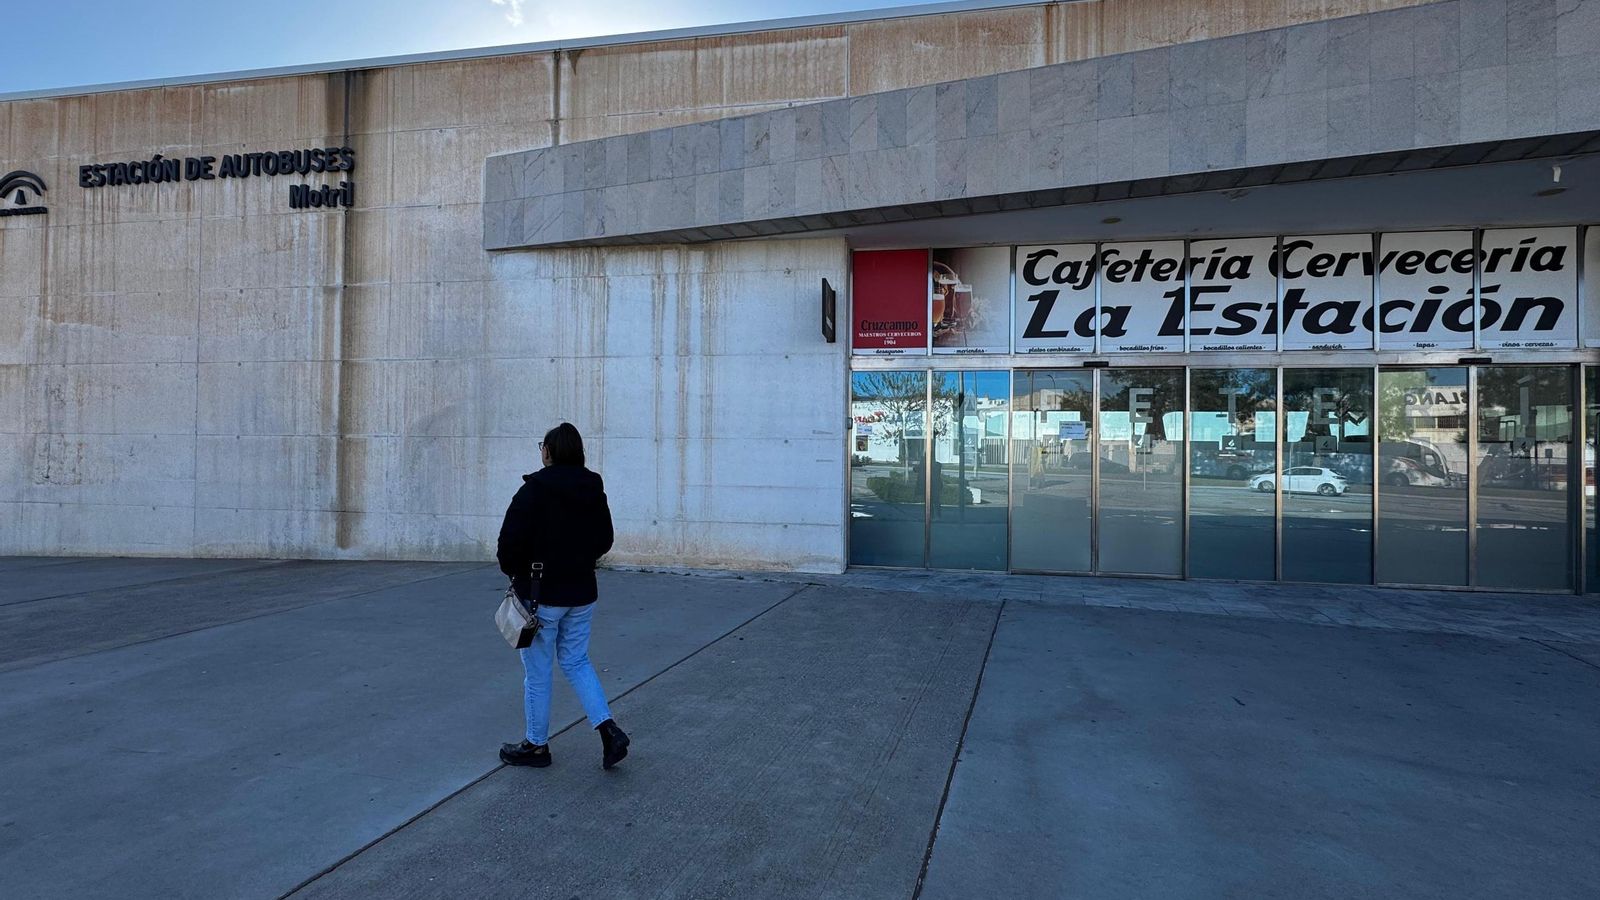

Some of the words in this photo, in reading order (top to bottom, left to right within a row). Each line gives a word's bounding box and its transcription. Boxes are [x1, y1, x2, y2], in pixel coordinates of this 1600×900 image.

[79, 154, 181, 188] ESTACIÓN
[184, 156, 216, 181] DE
[218, 147, 354, 178] AUTOBUSES
[288, 181, 354, 209] Motril
[1022, 247, 1254, 290] Cafetería
[1268, 236, 1567, 279] Cervecería
[861, 320, 918, 331] Cruzcampo
[1022, 289, 1132, 339] La
[1157, 284, 1564, 337] Estación
